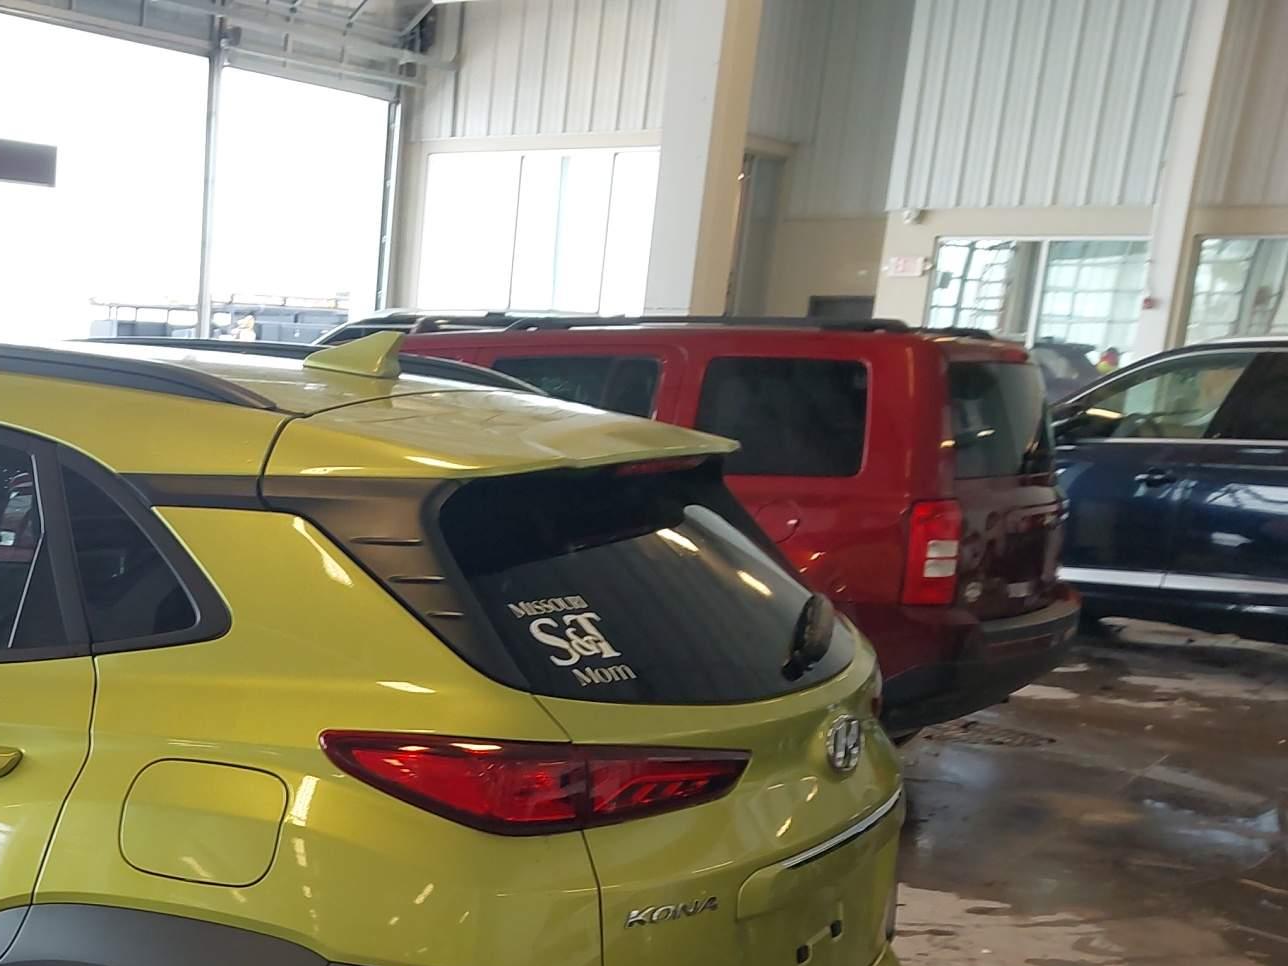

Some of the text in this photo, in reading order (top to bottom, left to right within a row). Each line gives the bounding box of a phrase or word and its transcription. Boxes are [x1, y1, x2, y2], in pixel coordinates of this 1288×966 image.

[528, 612, 622, 666] S&T
[571, 664, 637, 686] Mom
[624, 896, 719, 929] KONA
